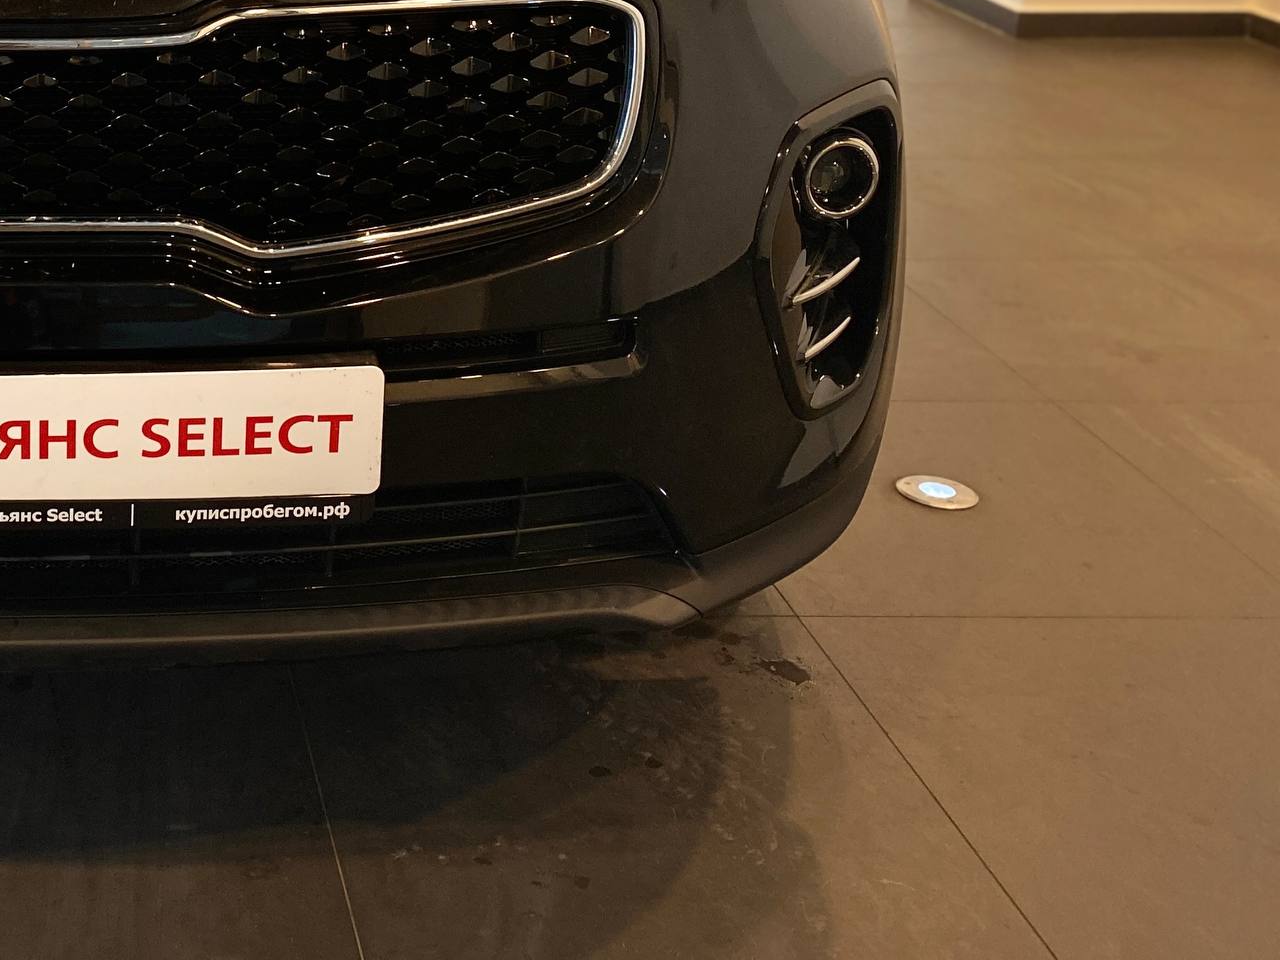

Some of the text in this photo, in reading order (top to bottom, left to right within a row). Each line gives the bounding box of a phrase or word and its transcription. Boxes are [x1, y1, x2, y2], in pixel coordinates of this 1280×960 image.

[141, 414, 354, 458] SELECT
[46, 507, 103, 523] Select
[175, 502, 351, 524] куписпробегом.рф
